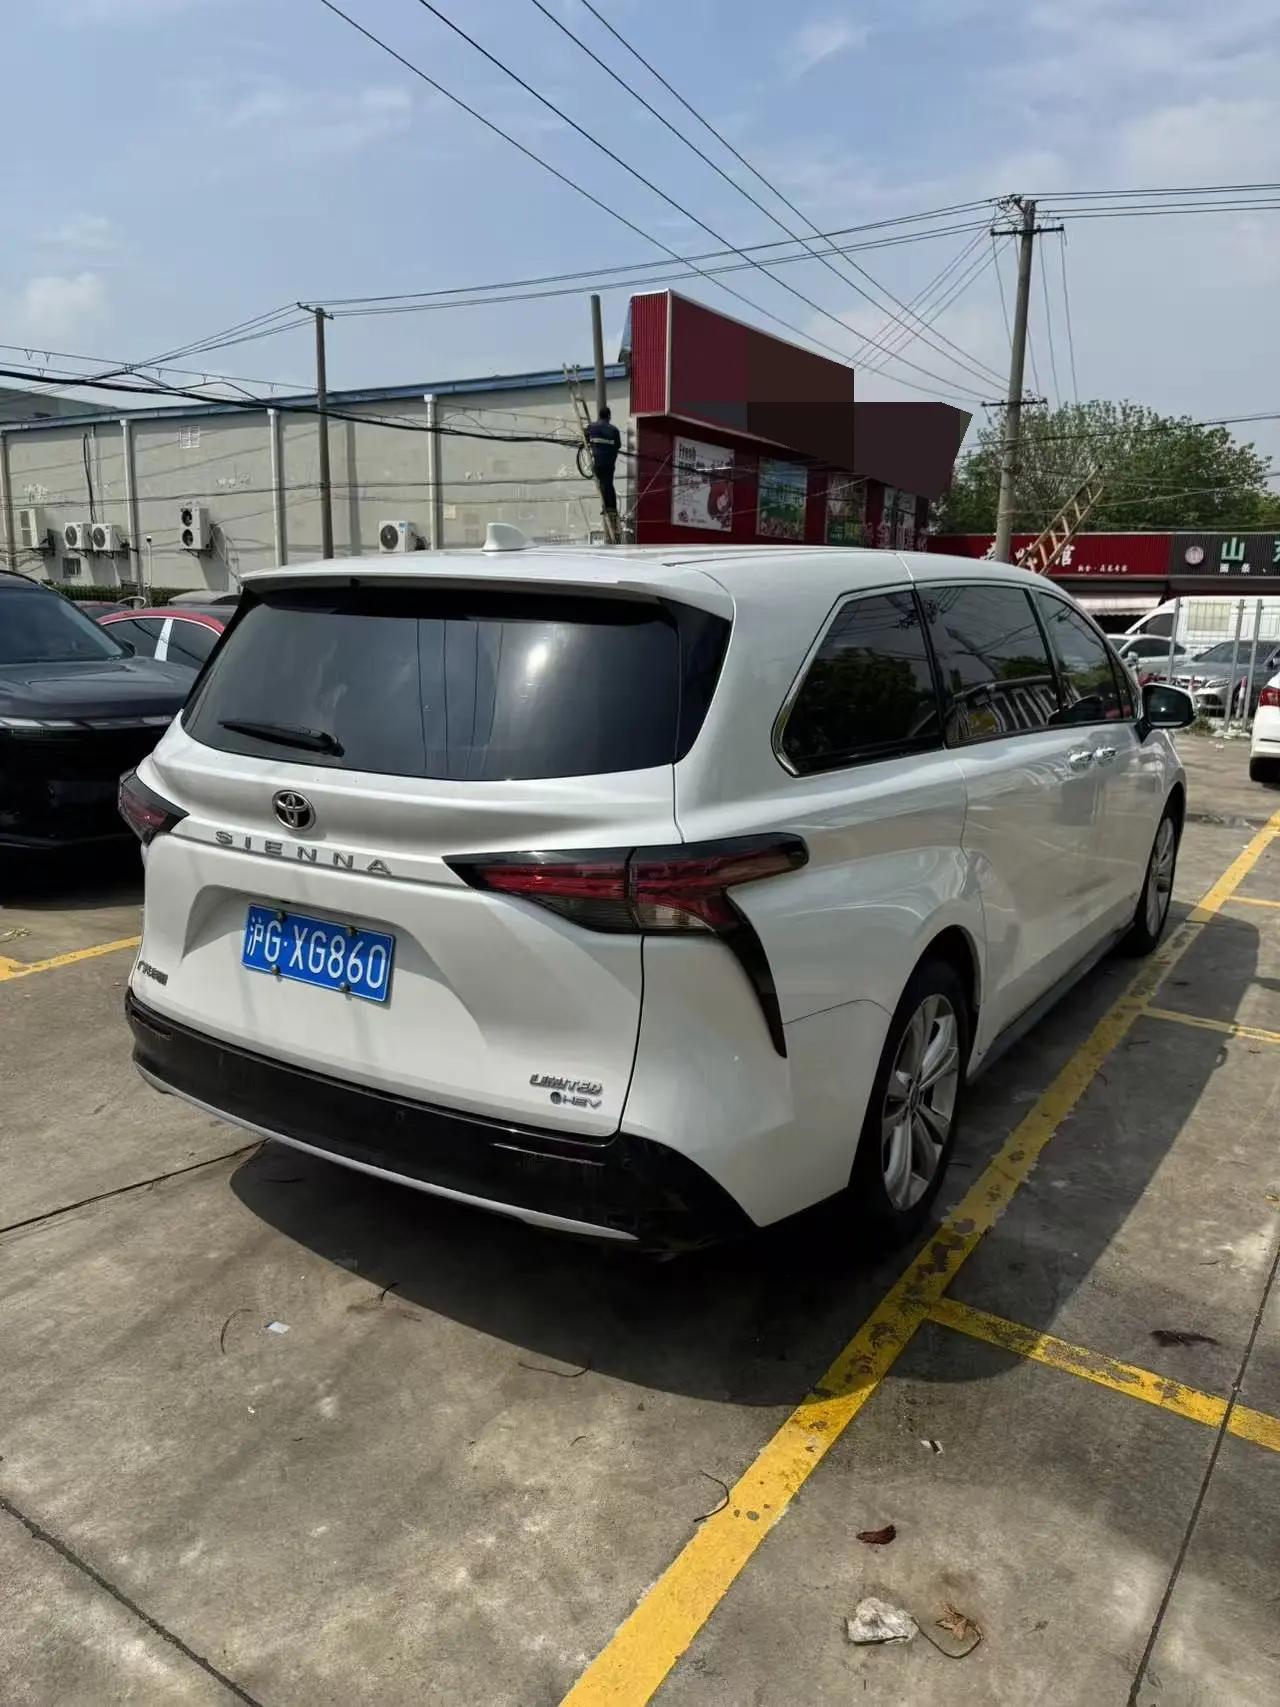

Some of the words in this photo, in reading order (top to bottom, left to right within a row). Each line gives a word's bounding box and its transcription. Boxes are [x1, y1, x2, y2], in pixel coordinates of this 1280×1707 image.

[215, 830, 392, 876] SIENNA
[247, 915, 386, 989] 沪G·XG860
[529, 1073, 603, 1096] LIMITED
